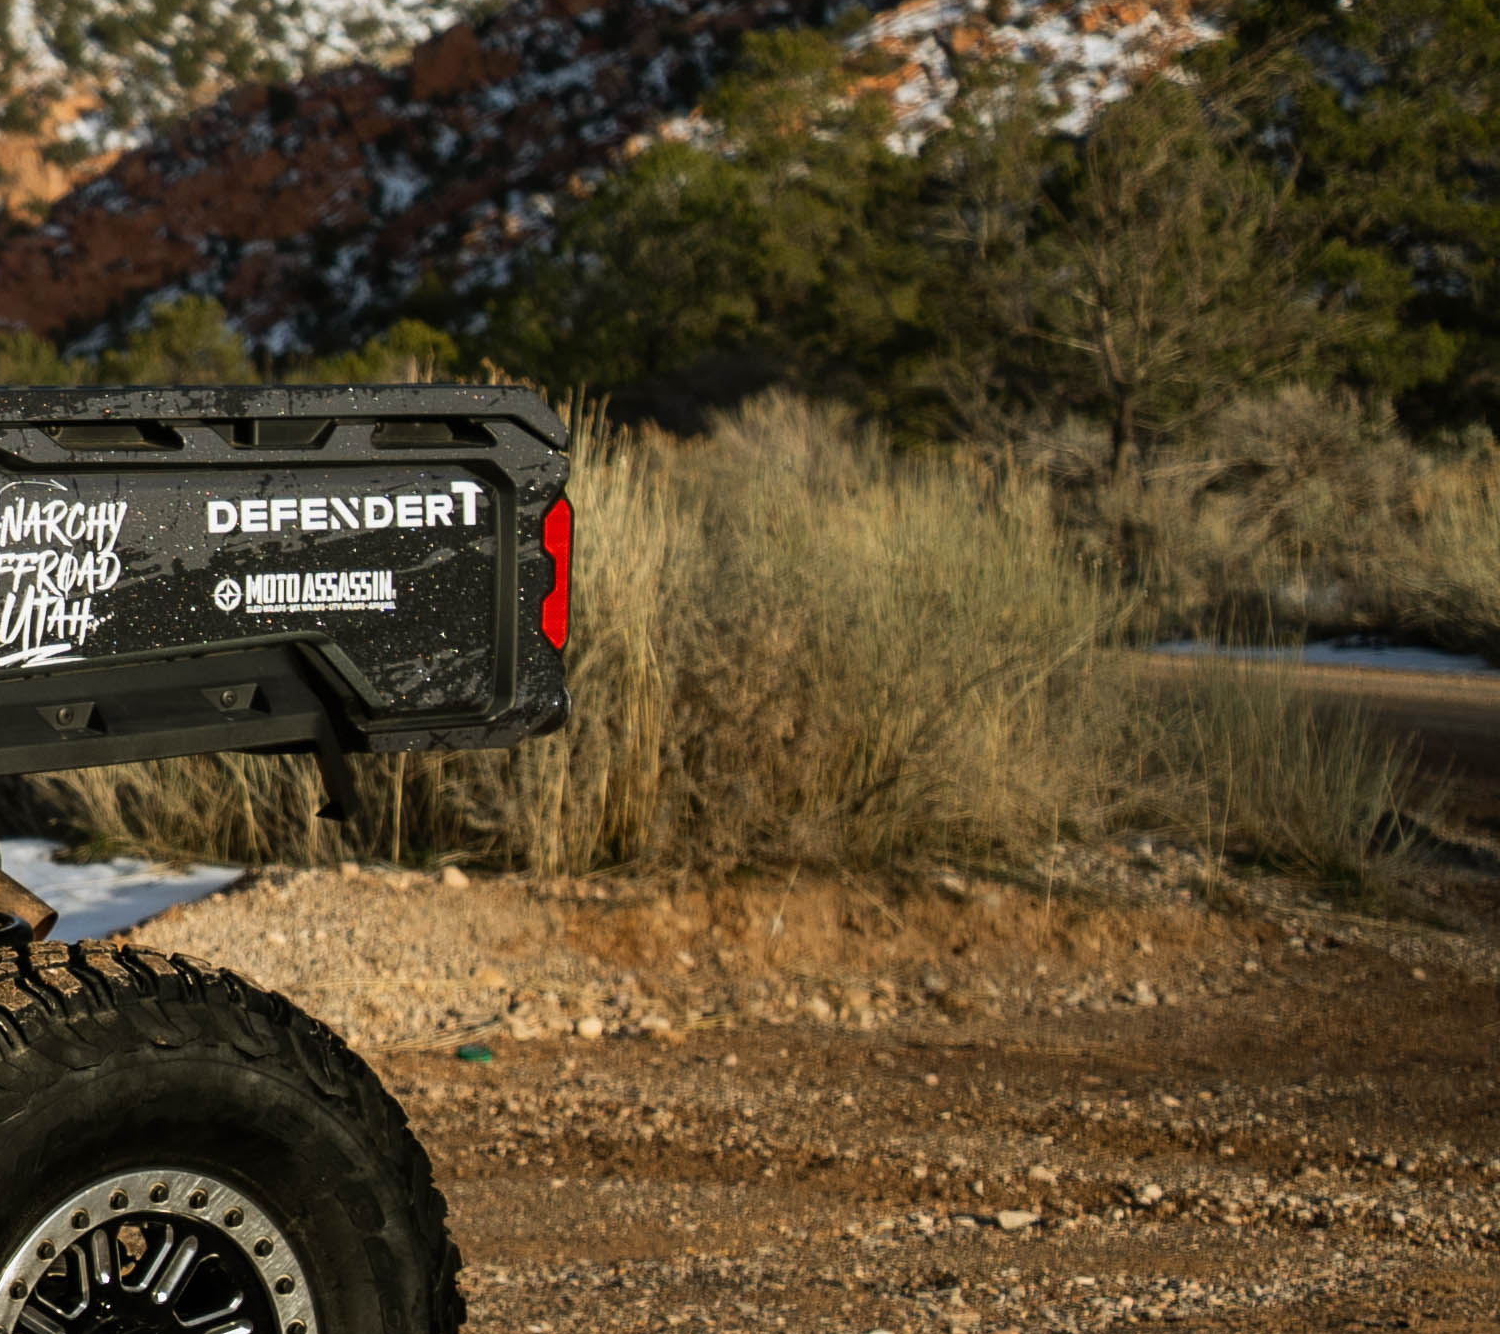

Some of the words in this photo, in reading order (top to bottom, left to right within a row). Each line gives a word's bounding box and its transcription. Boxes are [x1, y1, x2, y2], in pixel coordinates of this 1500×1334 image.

[245, 573, 299, 604] MOTO
[302, 570, 392, 602] ASSASSIN
[0, 584, 94, 650] UTAH
